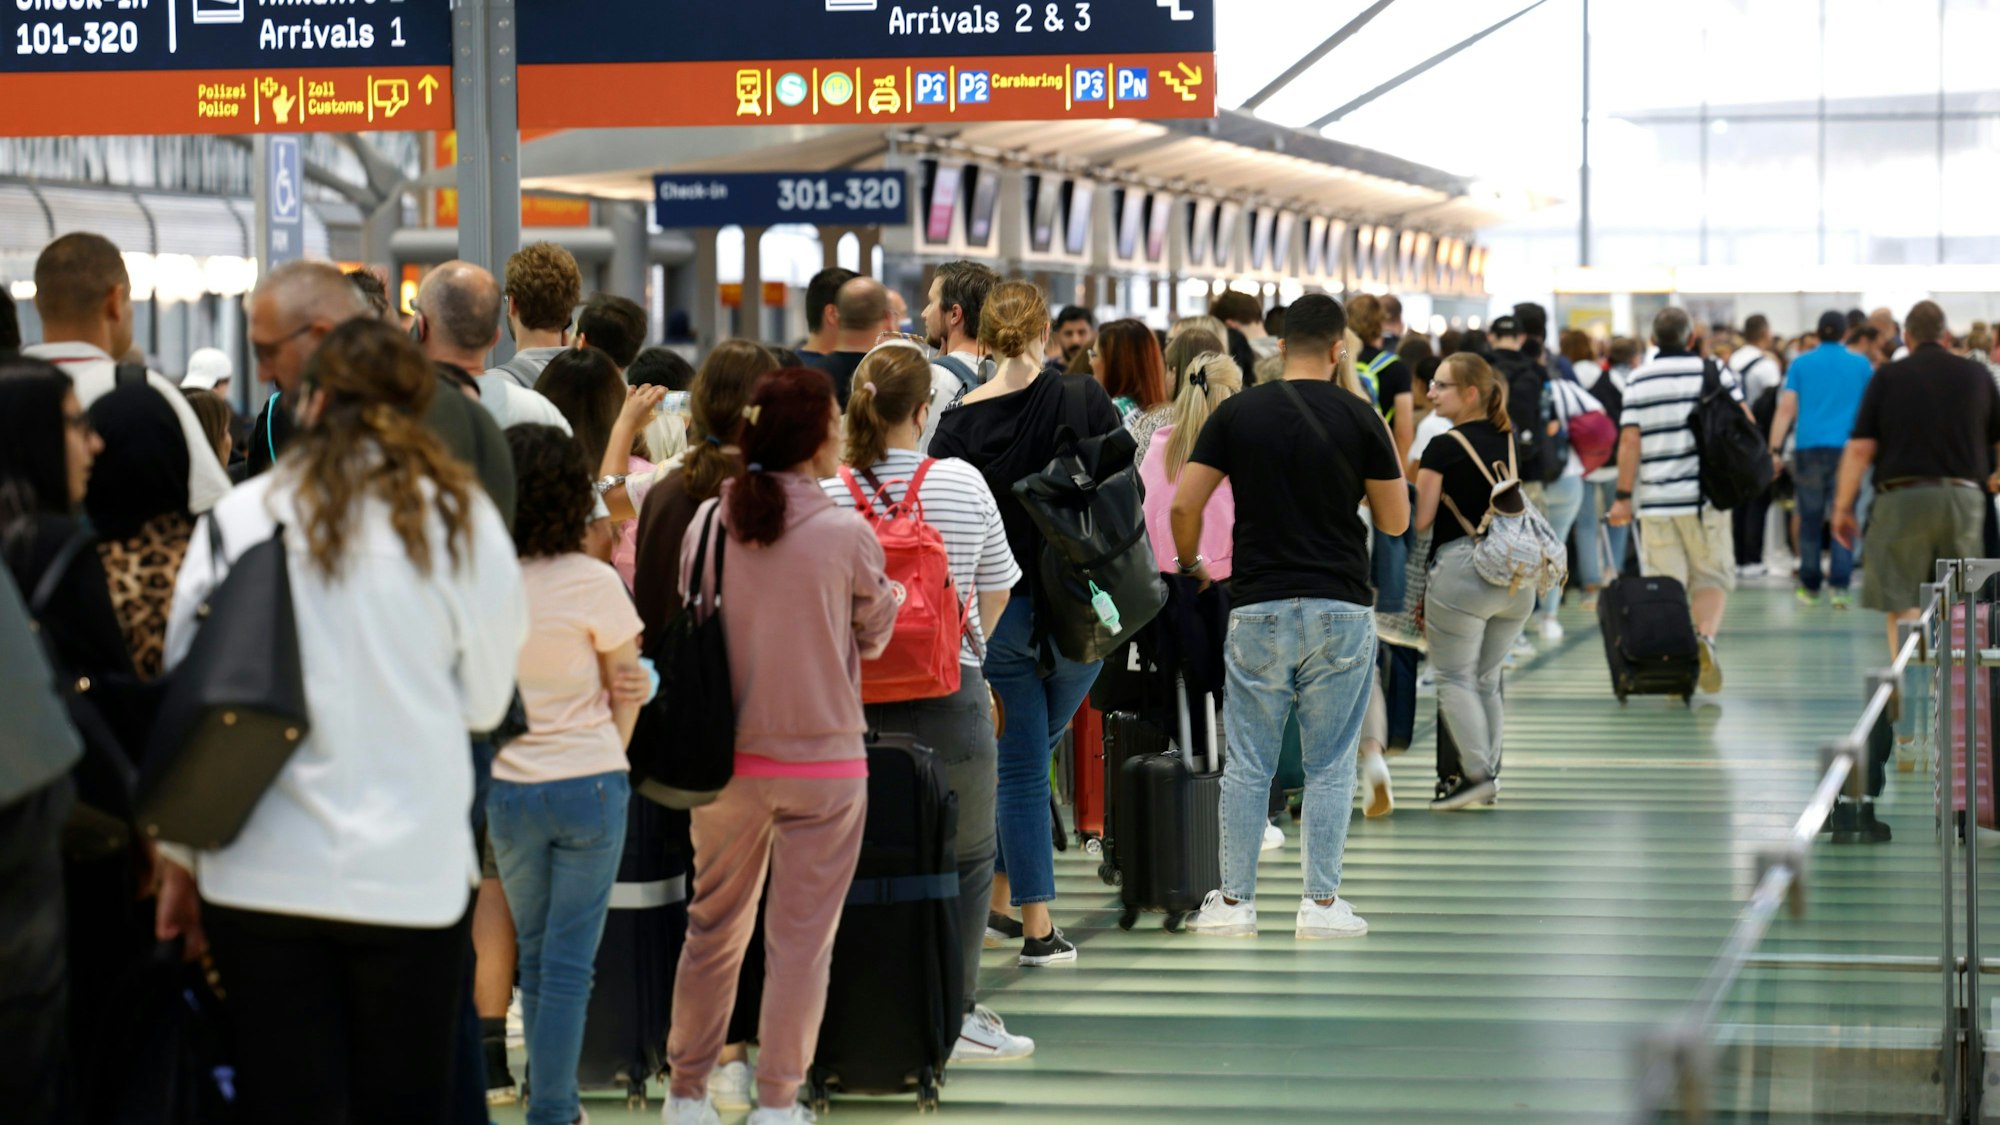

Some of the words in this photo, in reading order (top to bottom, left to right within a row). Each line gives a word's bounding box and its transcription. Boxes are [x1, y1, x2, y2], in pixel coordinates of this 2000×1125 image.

[889, 5, 1000, 35] Arrivals
[1015, 4, 1033, 32] 2
[1044, 3, 1065, 32] &
[1074, 2, 1091, 31] 3
[17, 21, 138, 54] 101-320
[259, 17, 375, 49] Arrivals
[390, 16, 406, 47] 1
[198, 83, 246, 100] Polizei
[308, 81, 335, 97] Zoll
[780, 75, 802, 102] S
[991, 73, 1063, 90] Carsharing
[198, 101, 239, 117] Police
[308, 99, 364, 115] Customs
[660, 180, 728, 200] Check-in
[777, 178, 901, 211] 301-320
